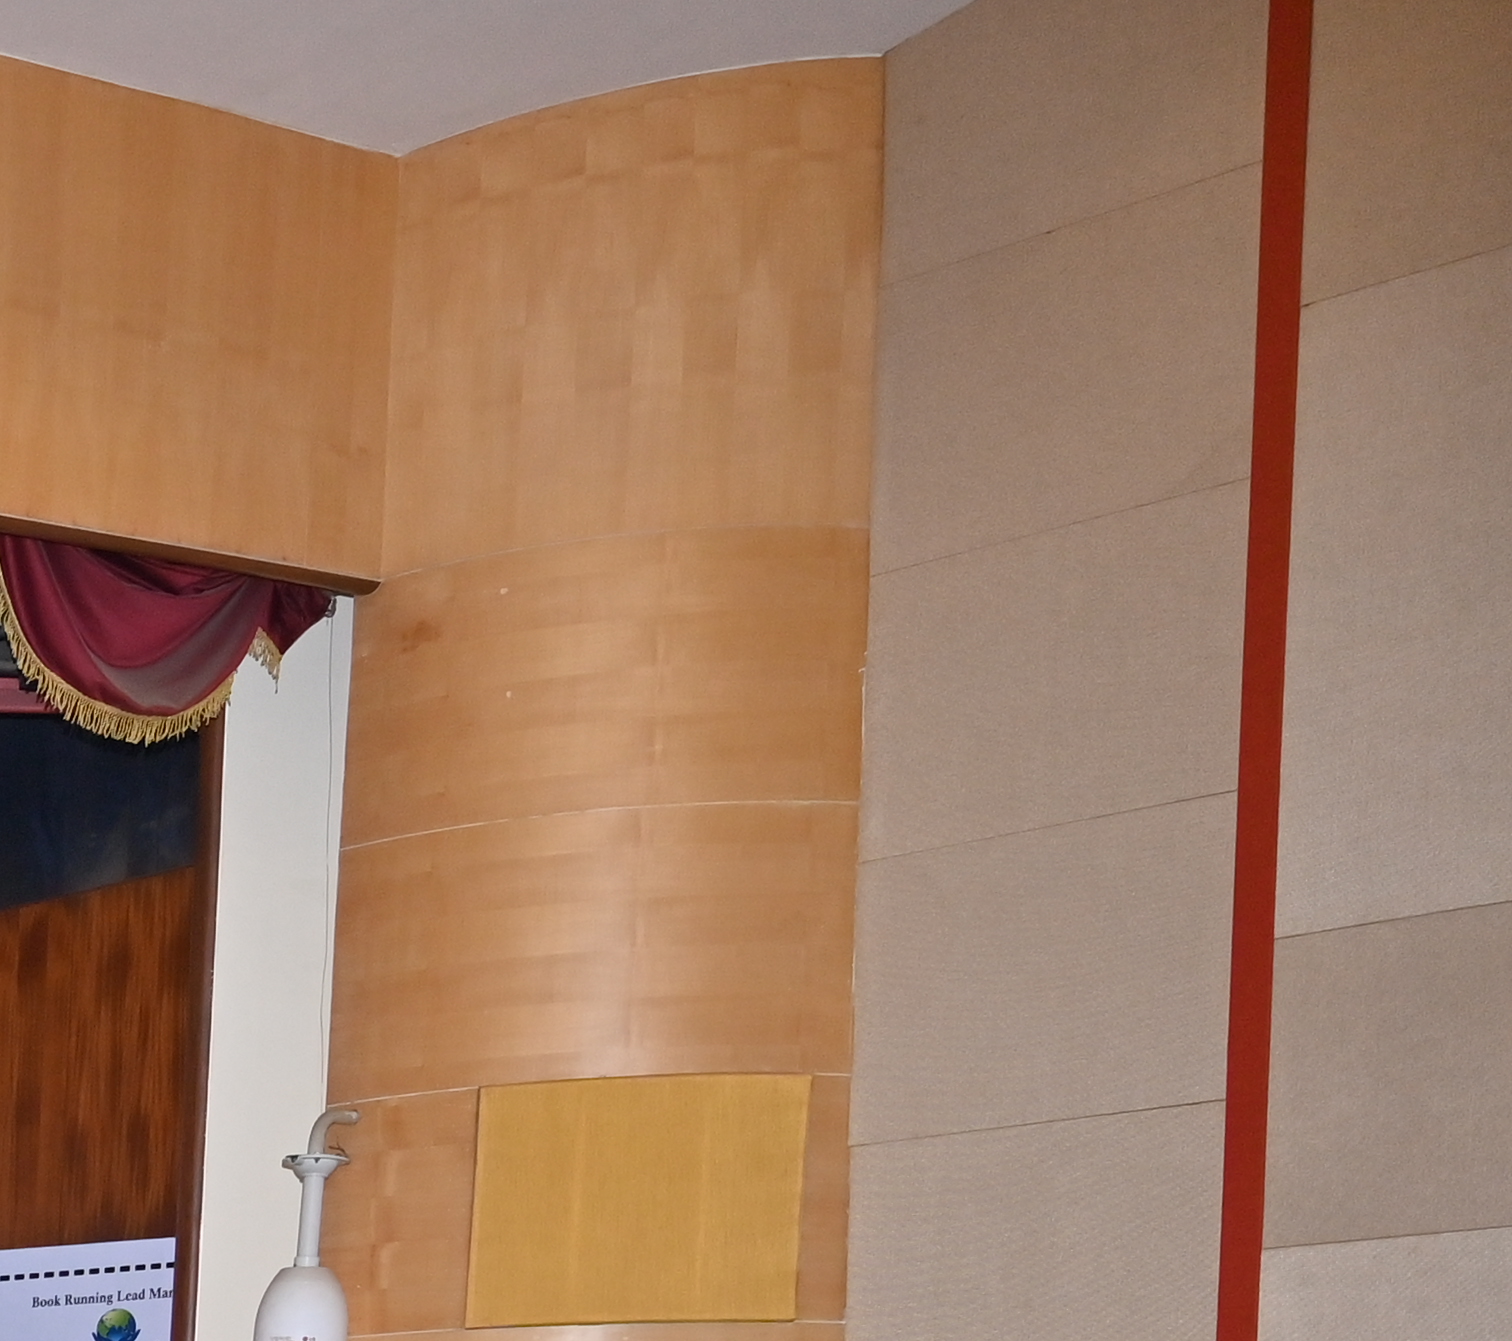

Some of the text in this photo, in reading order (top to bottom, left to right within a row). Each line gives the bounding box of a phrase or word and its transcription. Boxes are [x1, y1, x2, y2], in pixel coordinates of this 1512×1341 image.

[32, 1295, 61, 1308] Book
[65, 1292, 113, 1305] Running
[117, 1289, 145, 1302] Lead
